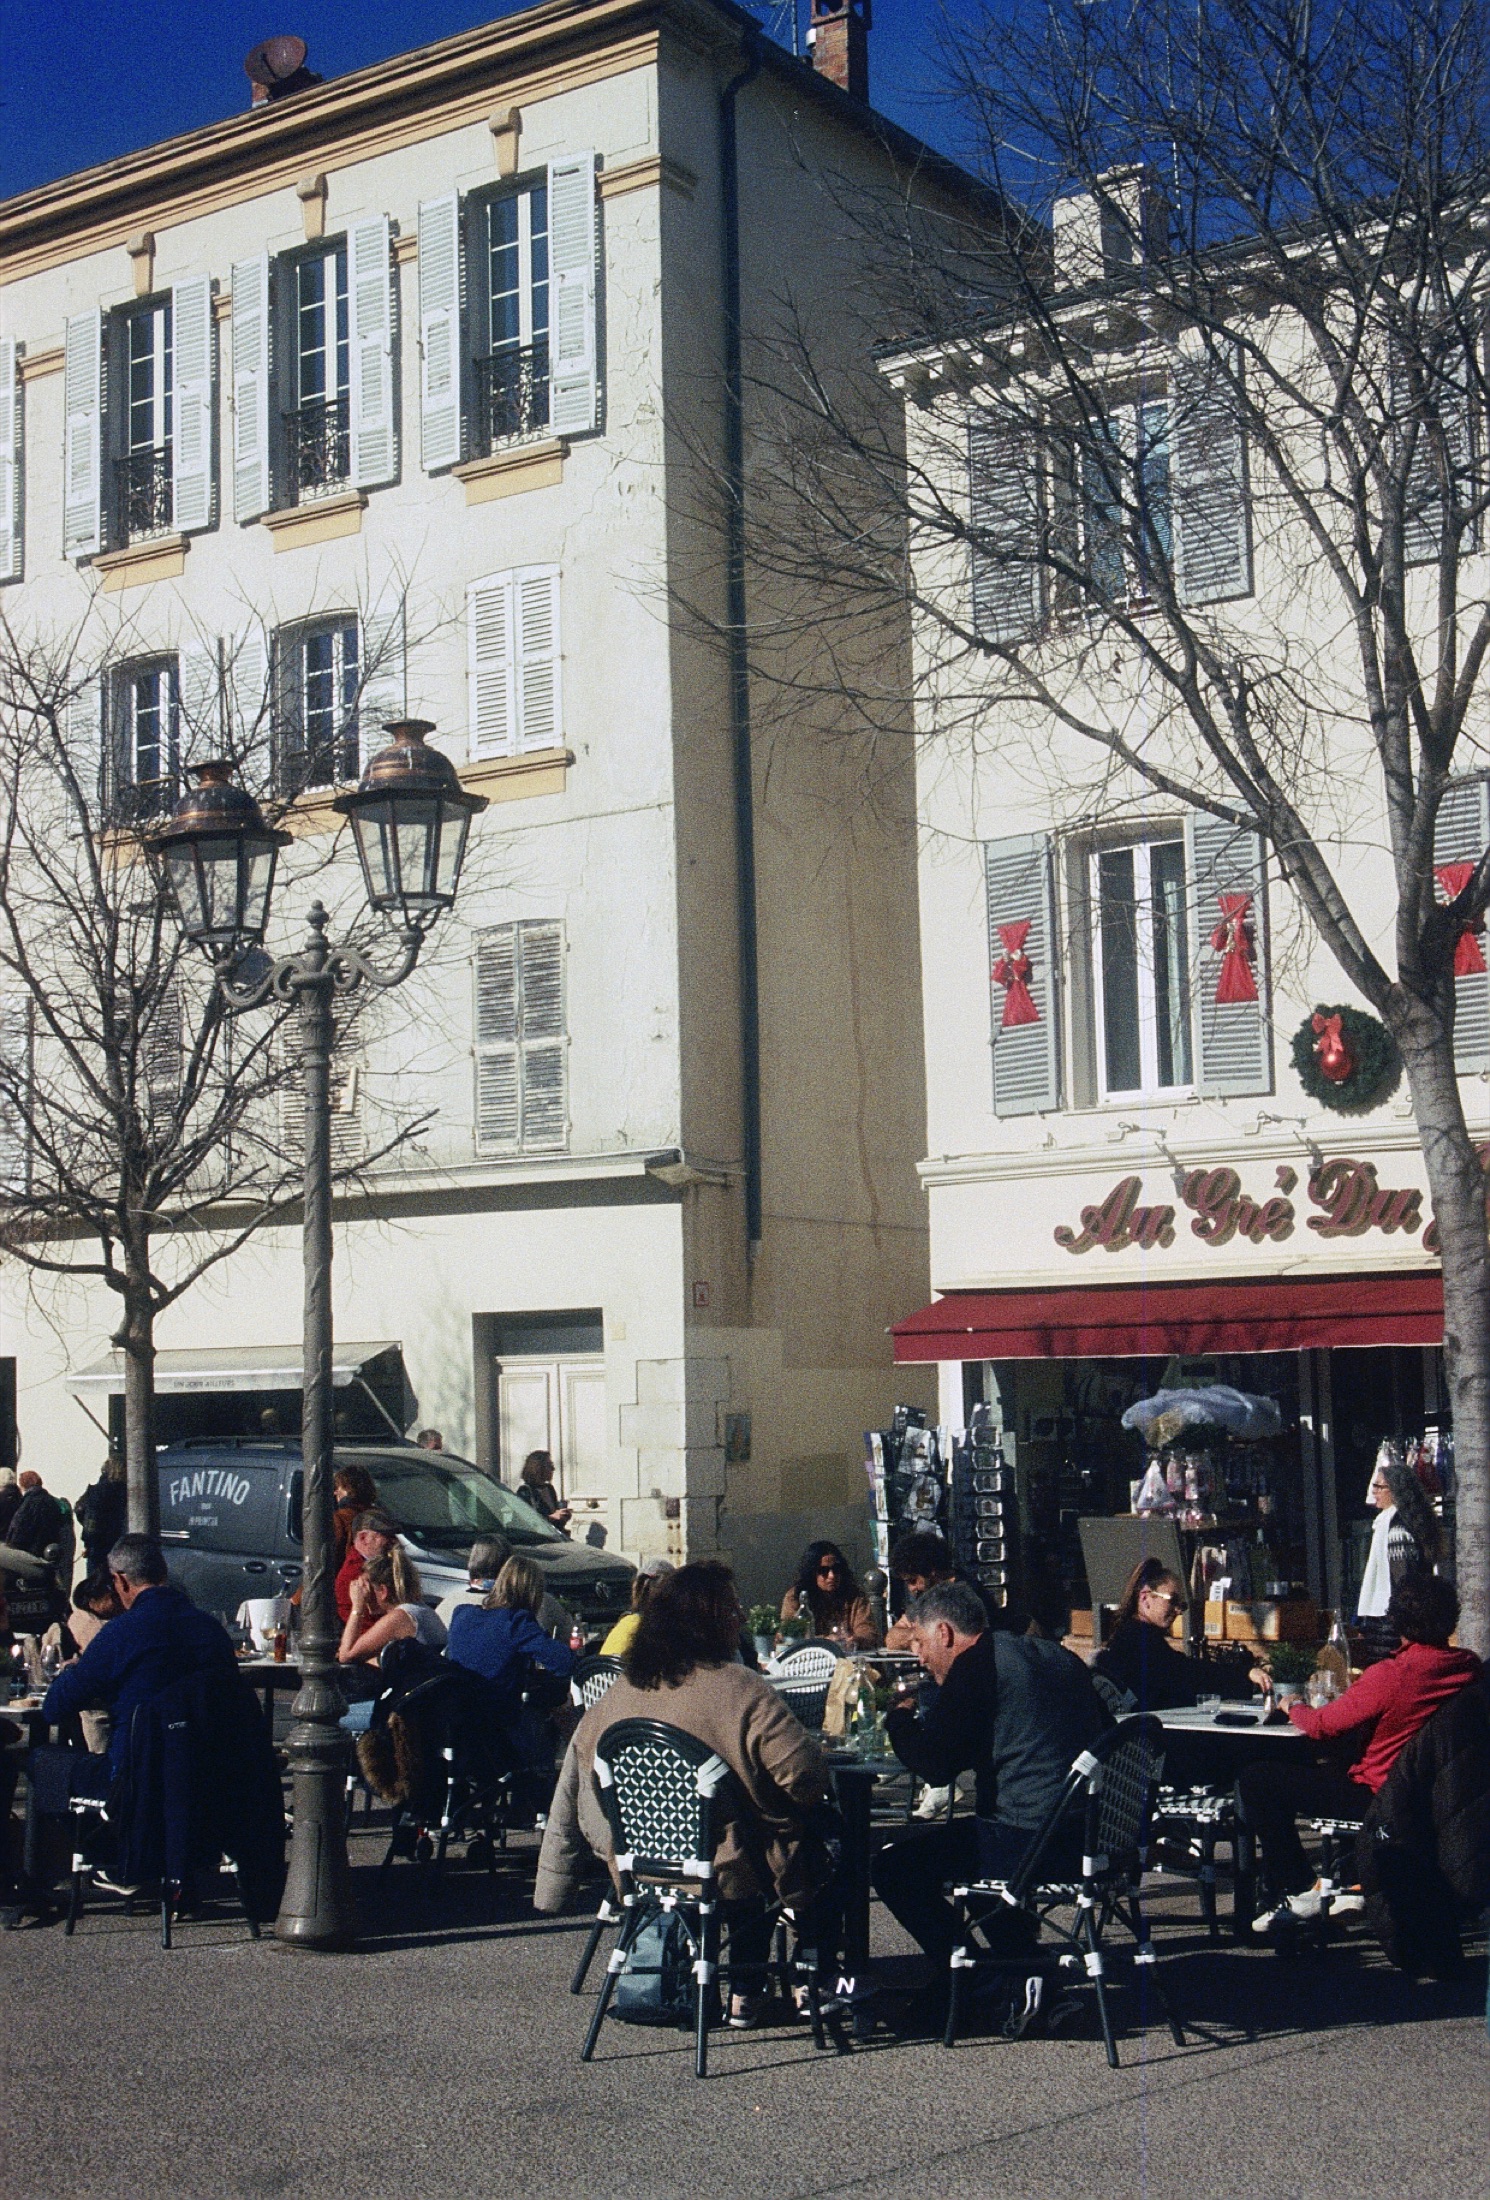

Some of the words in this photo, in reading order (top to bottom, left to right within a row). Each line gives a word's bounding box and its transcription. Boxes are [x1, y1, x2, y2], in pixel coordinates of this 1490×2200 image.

[1054, 1175, 1176, 1254] Au
[1181, 1165, 1299, 1245] Gré
[1305, 1157, 1424, 1238] Du
[170, 1470, 250, 1506] FANTINO
[835, 1977, 855, 1994] N
